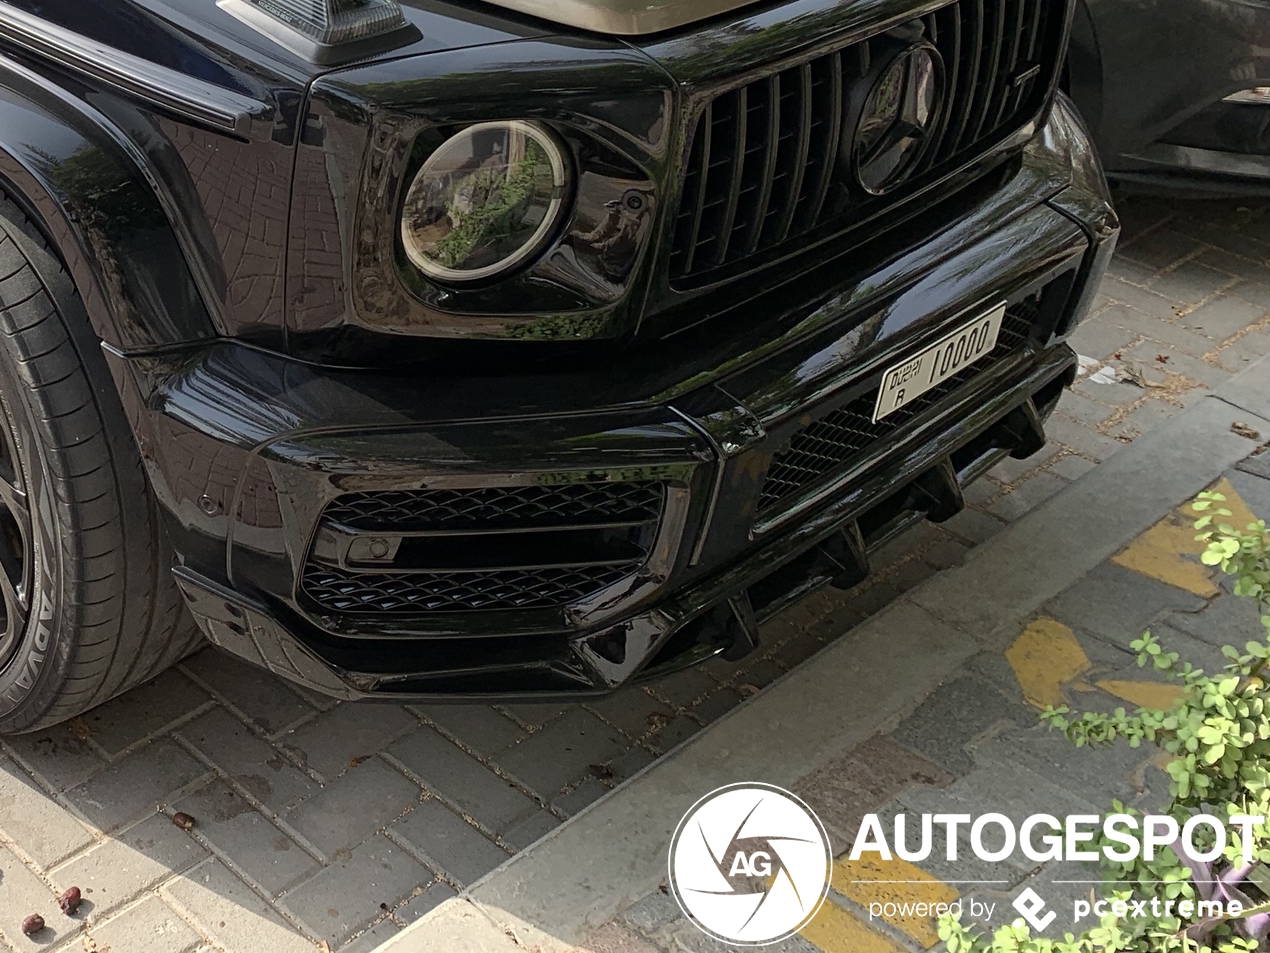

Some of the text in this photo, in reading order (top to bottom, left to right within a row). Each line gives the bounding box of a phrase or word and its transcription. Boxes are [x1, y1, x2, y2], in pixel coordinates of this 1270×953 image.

[929, 320, 991, 384] 10000
[893, 388, 906, 408] R
[1, 589, 54, 706] ADVAN
